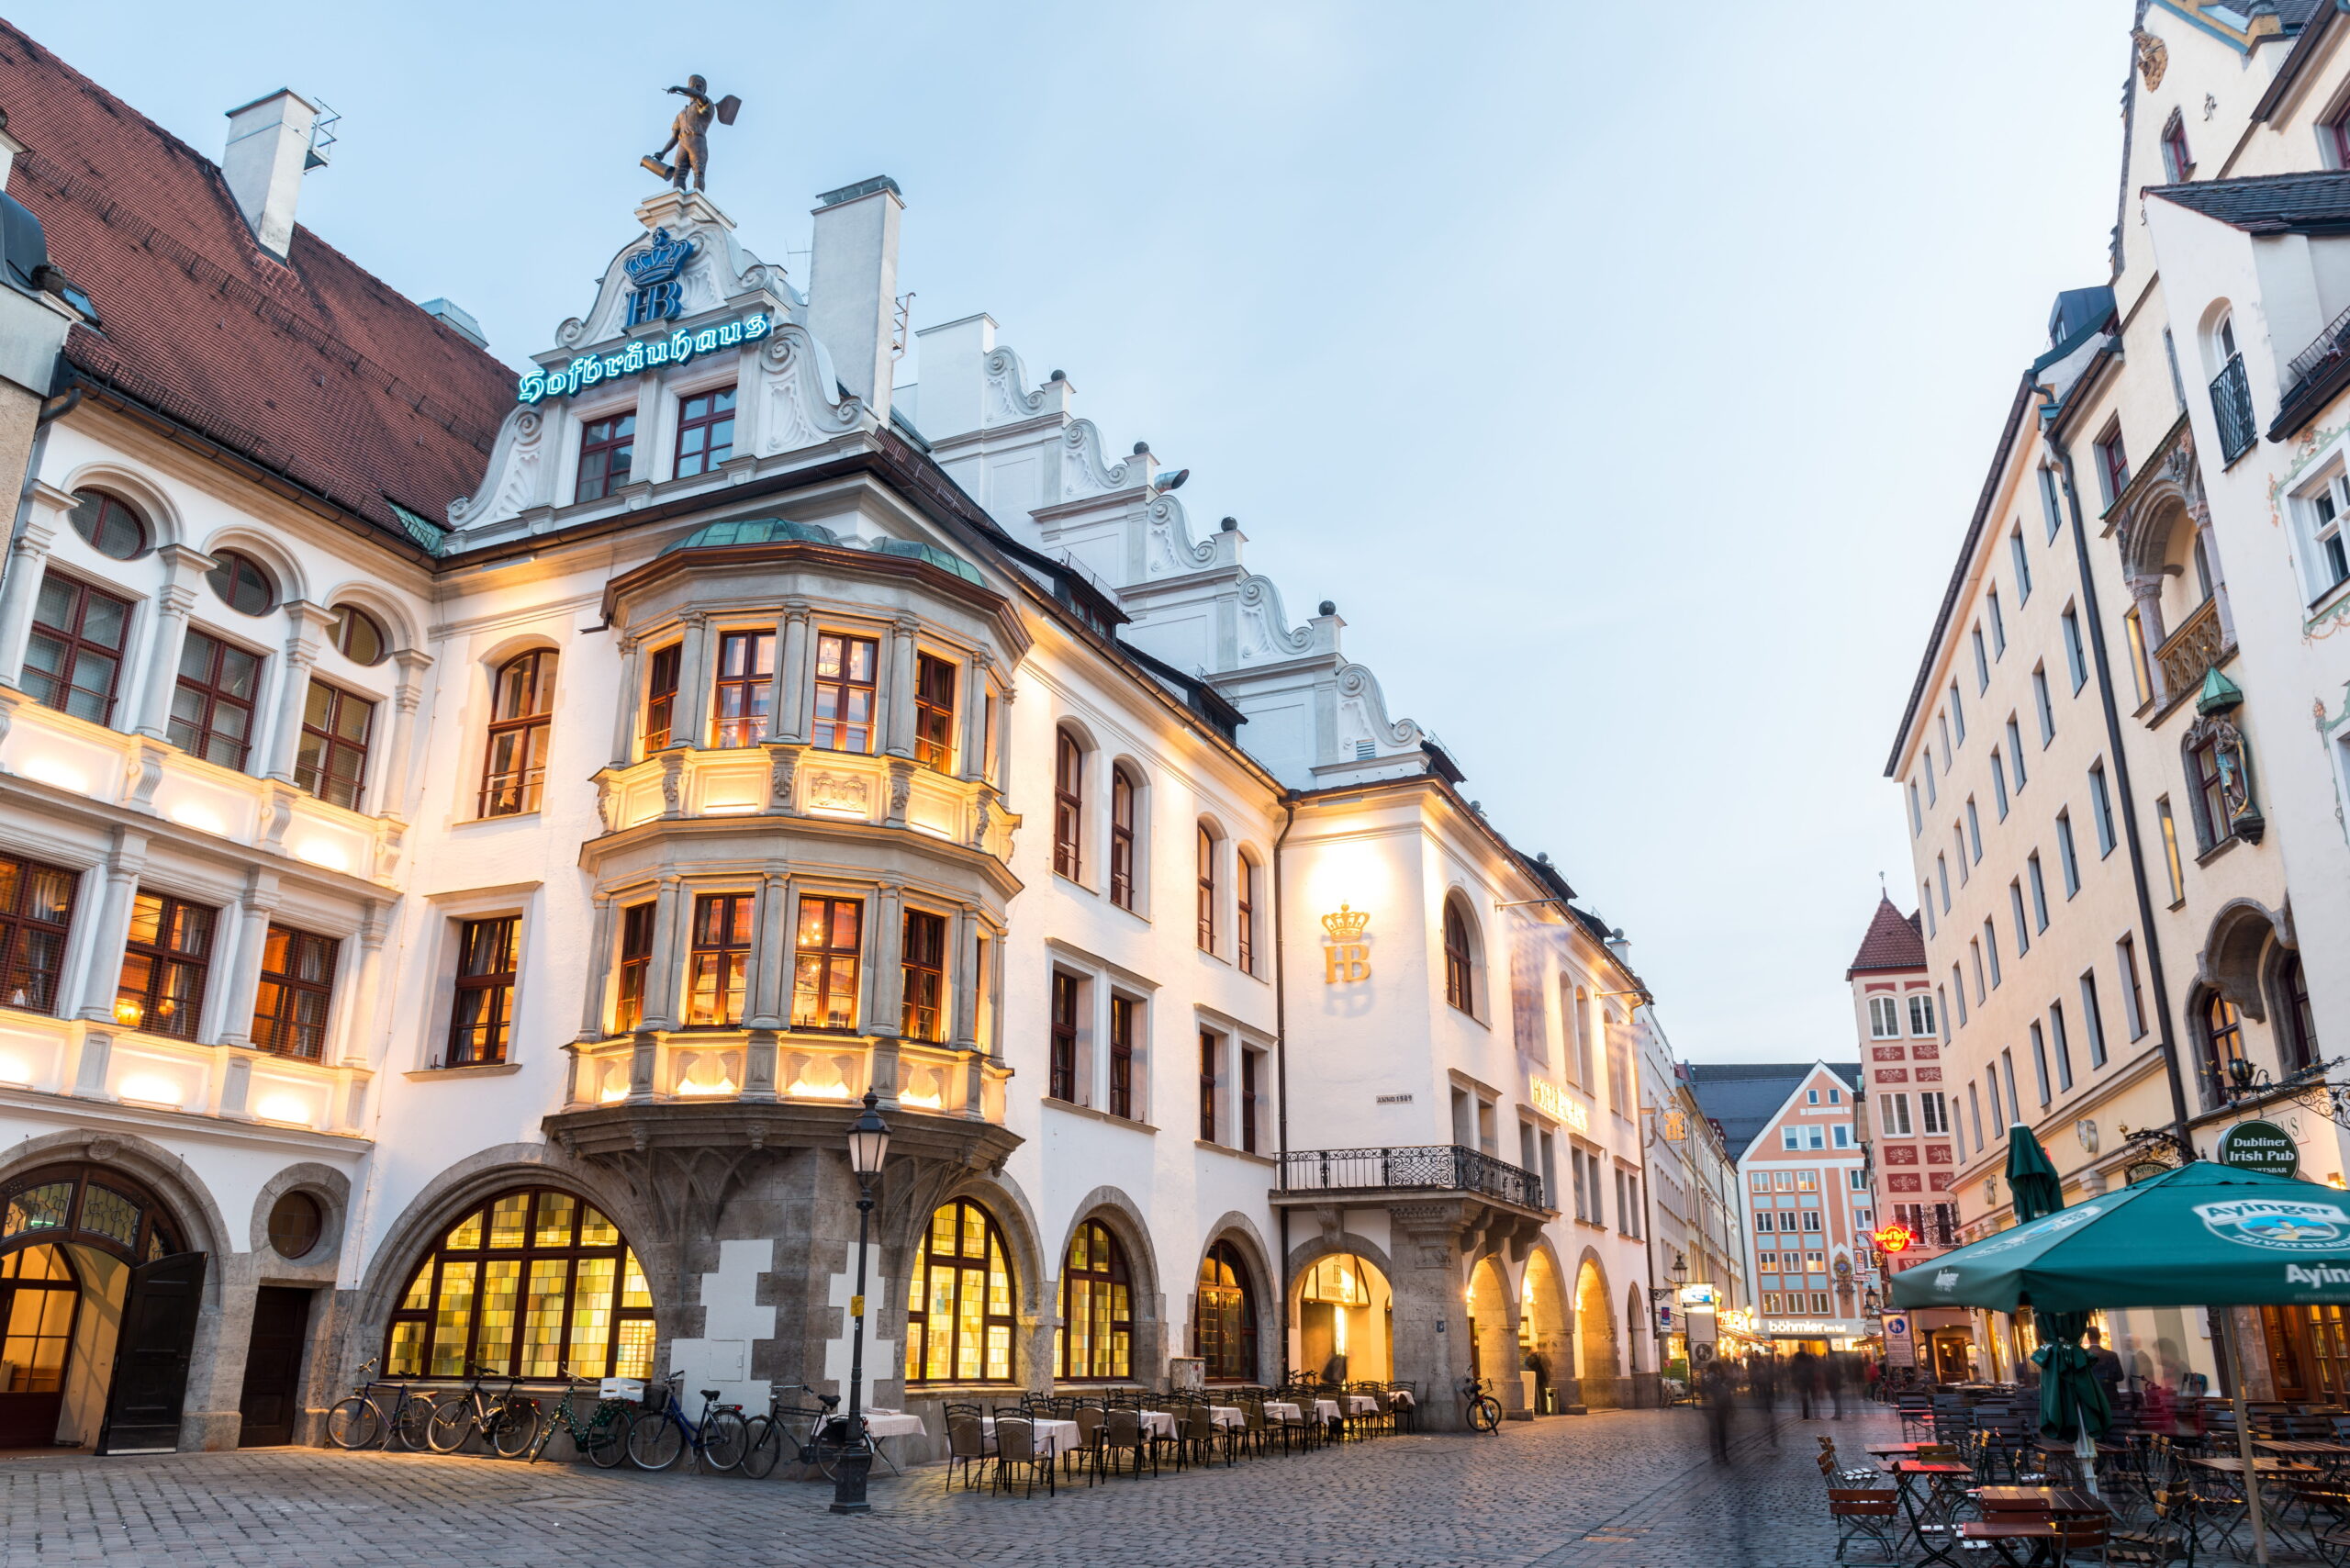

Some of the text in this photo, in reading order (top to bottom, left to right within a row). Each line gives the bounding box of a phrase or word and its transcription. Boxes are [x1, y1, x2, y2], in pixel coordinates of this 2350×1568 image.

[622, 280, 682, 333] HB
[518, 313, 771, 405] Hofbräuhaus
[1323, 945, 1371, 984] HB
[1665, 1123, 1685, 1140] HB
[2233, 1137, 2287, 1148] Dubliner
[2230, 1150, 2295, 1161] Irish Pub
[2207, 1203, 2334, 1217] Ayinger
[1874, 1230, 1910, 1241] Hard Rock
[1768, 1321, 1824, 1333] böhmler
